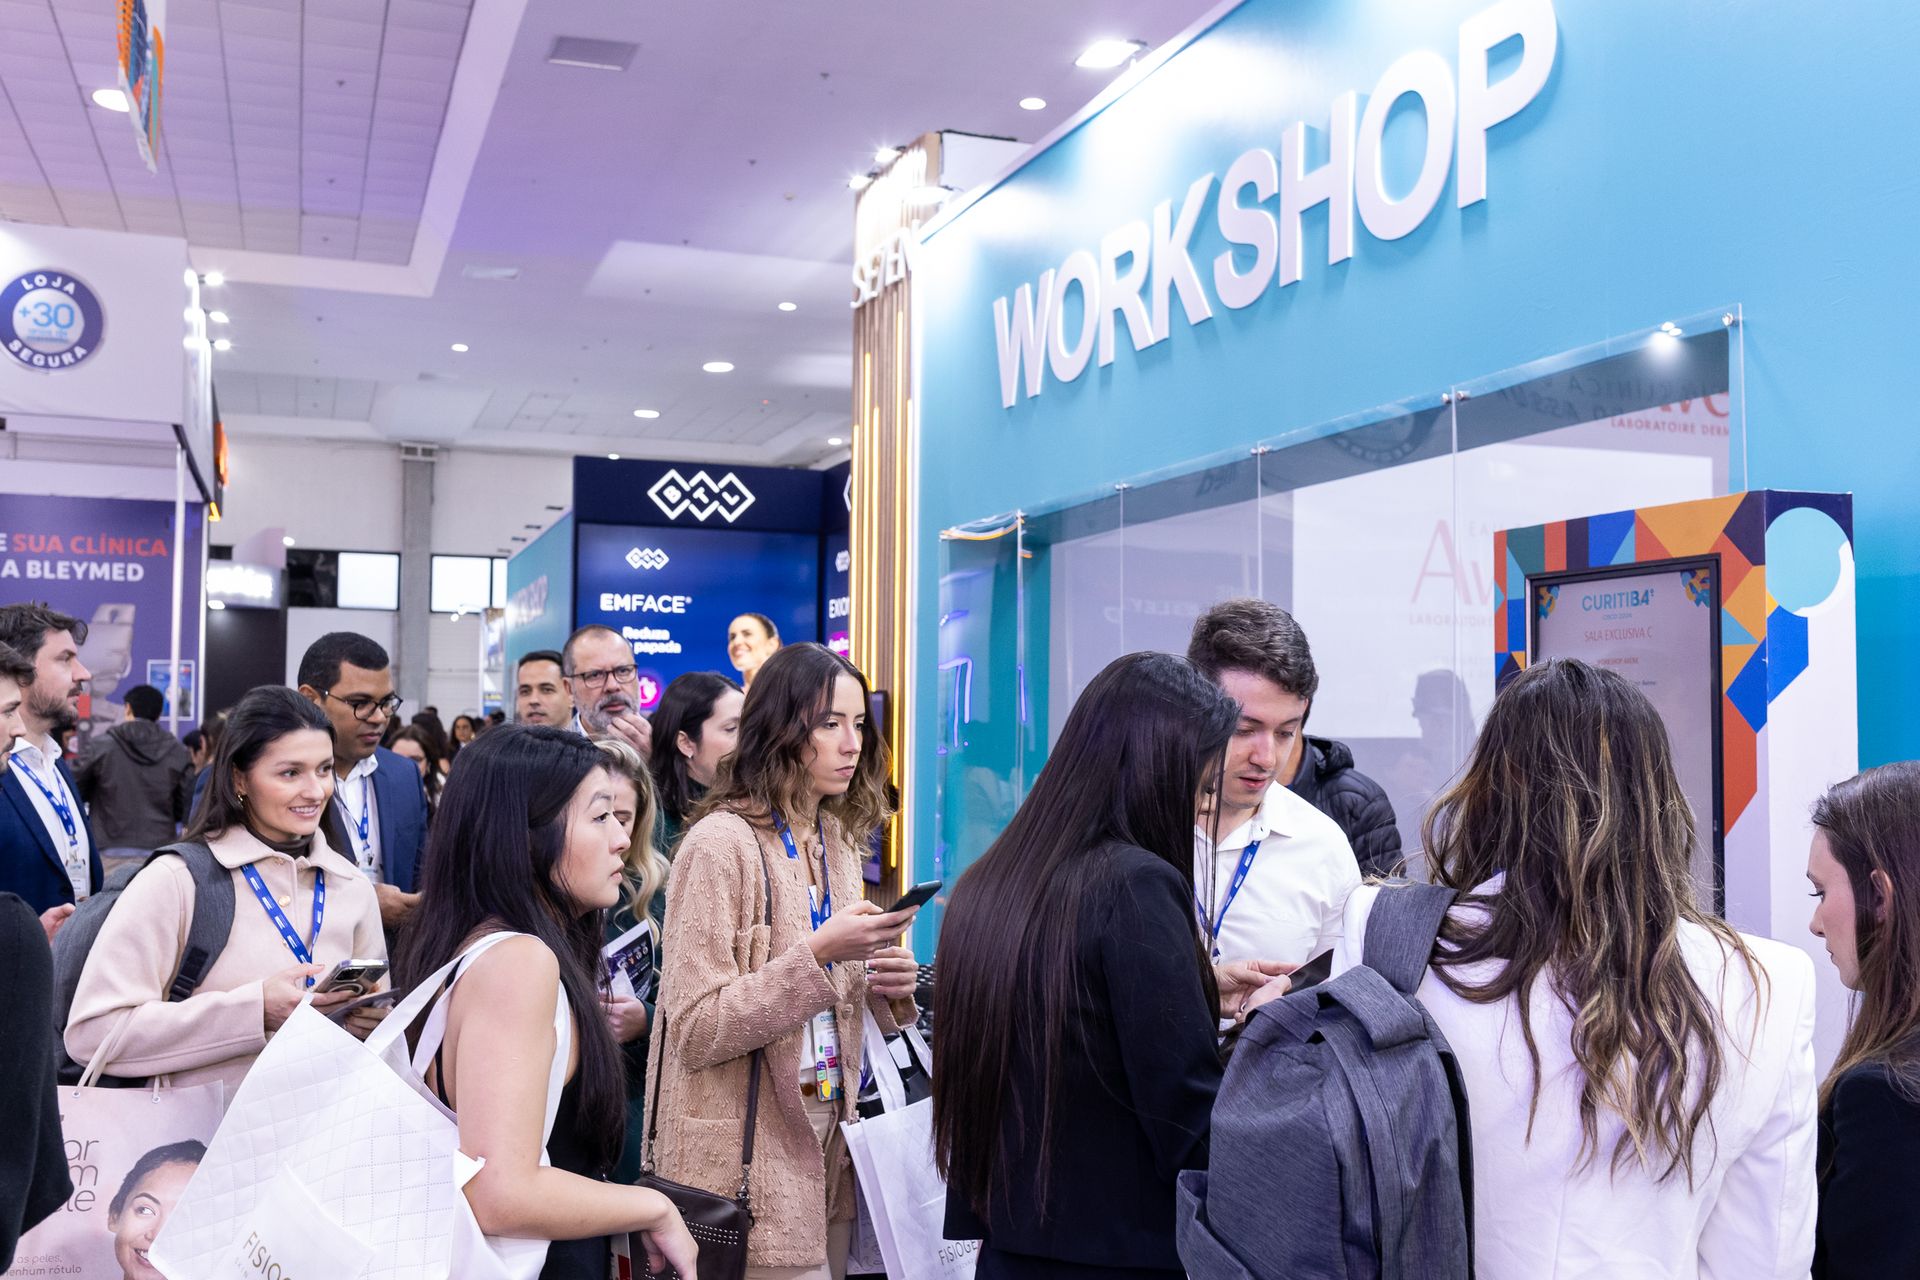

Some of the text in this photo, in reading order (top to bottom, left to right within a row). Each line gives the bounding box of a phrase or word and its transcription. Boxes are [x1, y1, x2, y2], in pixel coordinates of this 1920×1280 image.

[993, 0, 1559, 409] WORKSHOP
[21, 274, 75, 295] LOJA
[19, 302, 75, 329] +30
[9, 339, 87, 368] SEGURA
[1611, 417, 1696, 434] LABORATOIRE
[13, 533, 64, 553] SUA
[70, 533, 168, 557] CLÍNICA
[27, 560, 144, 582] BLEYMED
[243, 1231, 291, 1280] FISIO
[49, 1263, 83, 1275] rótulo
